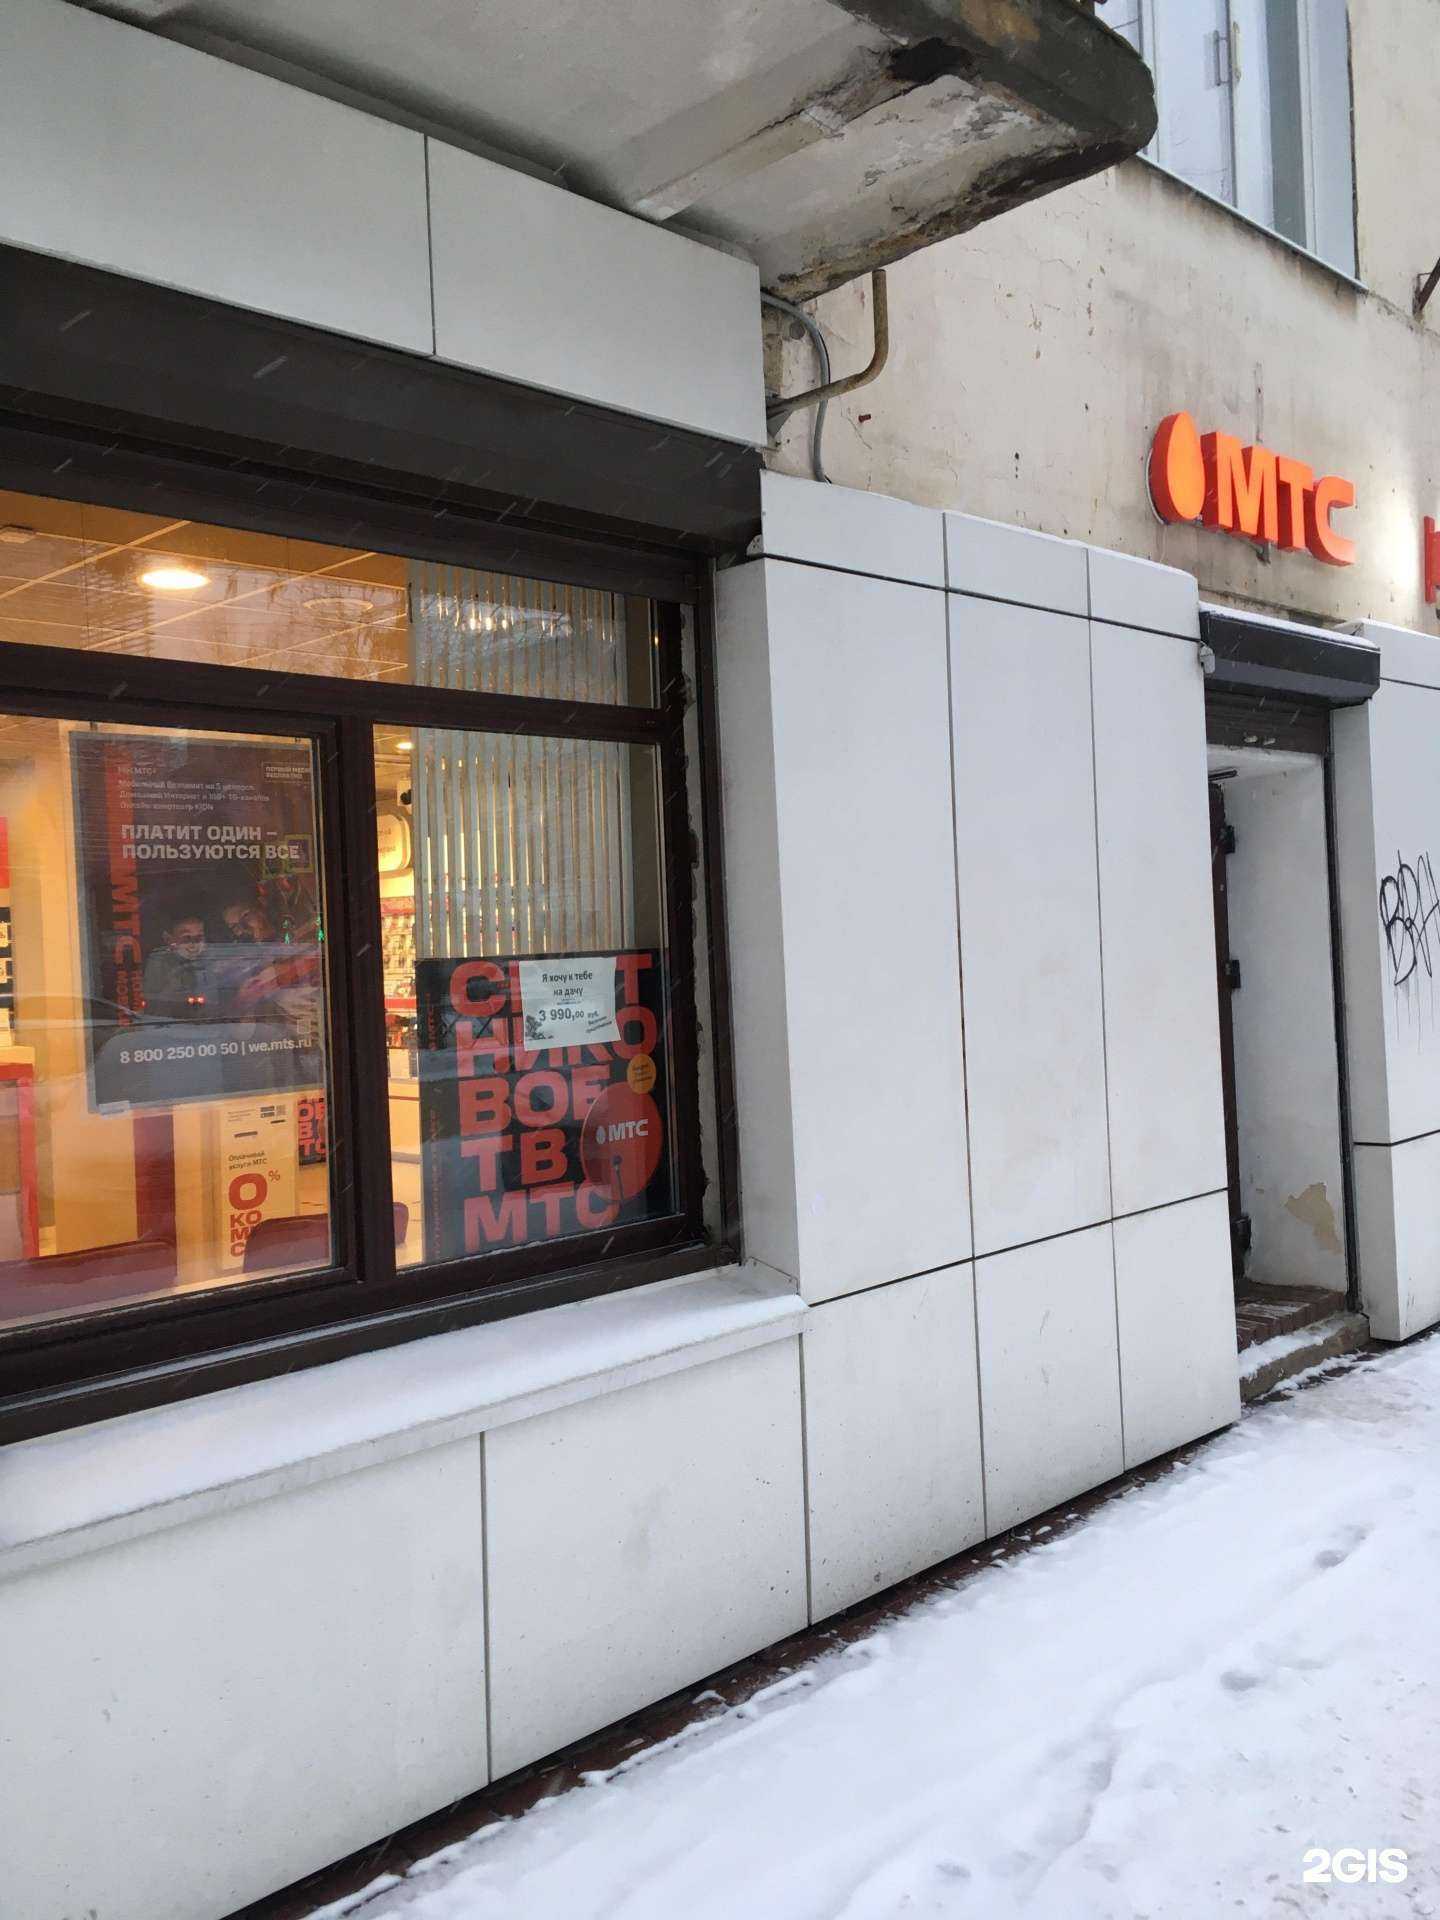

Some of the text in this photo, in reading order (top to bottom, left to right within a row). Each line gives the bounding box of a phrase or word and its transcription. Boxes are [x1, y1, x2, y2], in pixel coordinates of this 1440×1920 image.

[1201, 431, 1356, 567] МТС
[121, 824, 202, 840] ПЛАТИТ
[206, 825, 261, 842] ОДИН
[122, 844, 300, 860] ПОЛЬЗУЮТСЯ ВСЕ
[542, 973, 548, 983] Я
[574, 970, 593, 981] тебе
[553, 986, 583, 997] на дачу
[538, 1009, 546, 1022] 3
[119, 1051, 130, 1064] 8
[134, 1048, 163, 1063] 800
[166, 1045, 195, 1060] 250
[199, 1043, 217, 1057] 00
[220, 1042, 239, 1055] 50
[248, 1038, 312, 1053] we.mts.ru
[608, 1118, 649, 1143] МТС
[253, 1158, 268, 1166] МТС
[460, 1128, 568, 1193] ТВ
[464, 1181, 621, 1251] МТС
